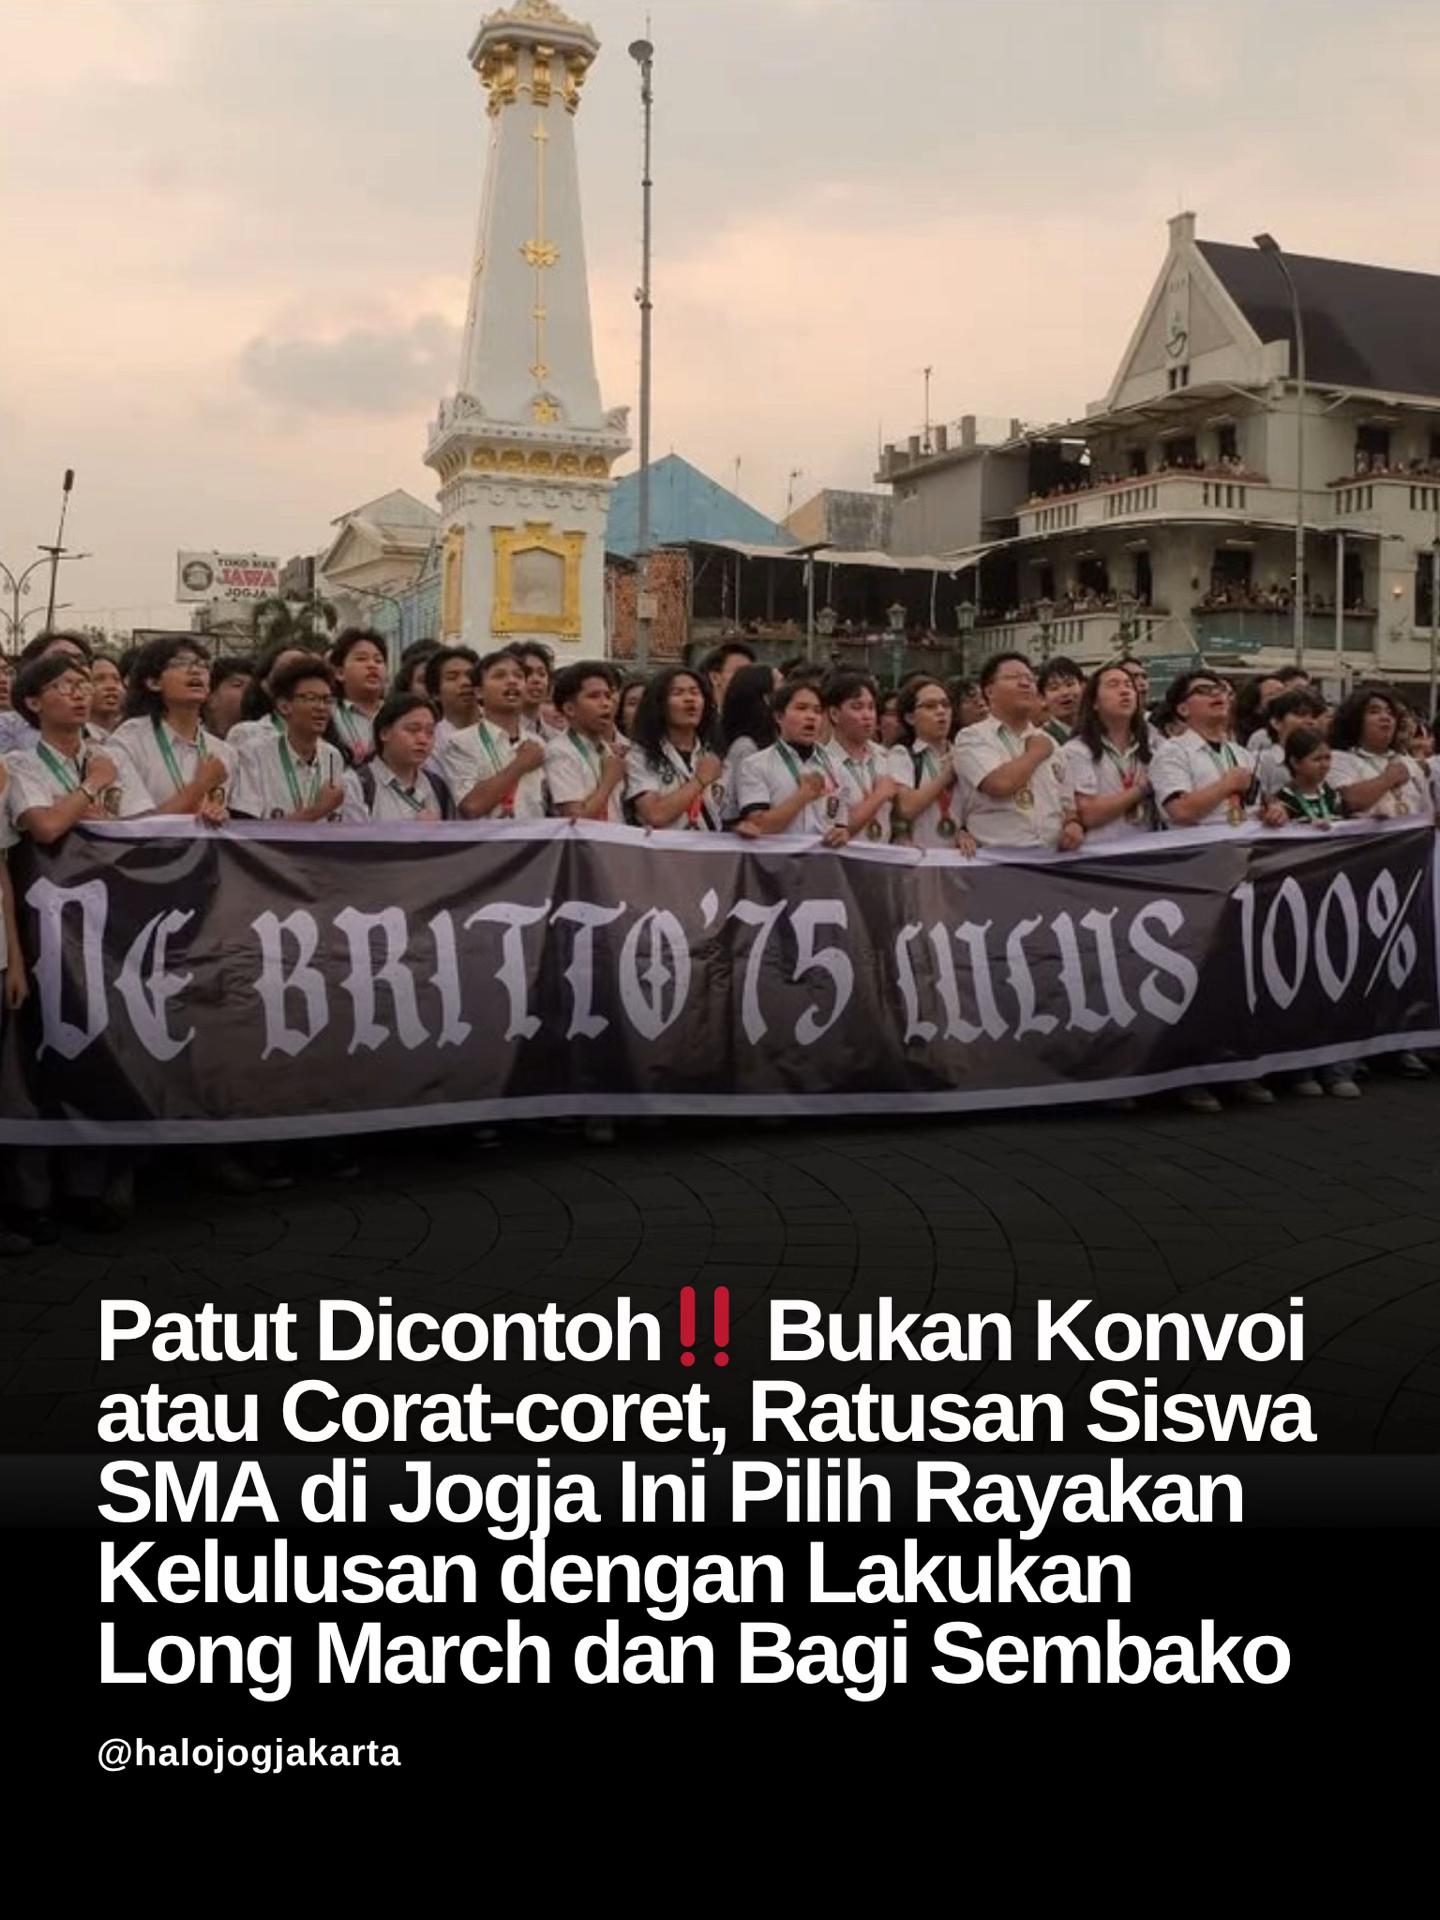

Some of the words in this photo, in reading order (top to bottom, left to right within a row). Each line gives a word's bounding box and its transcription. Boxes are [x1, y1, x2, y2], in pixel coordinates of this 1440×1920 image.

[218, 559, 249, 567] TOKO
[216, 568, 277, 587] JAWA
[224, 588, 268, 598] JOGJA
[25, 877, 196, 1062] DE
[894, 899, 1199, 1046] LULUS
[1231, 867, 1423, 1014] 100%
